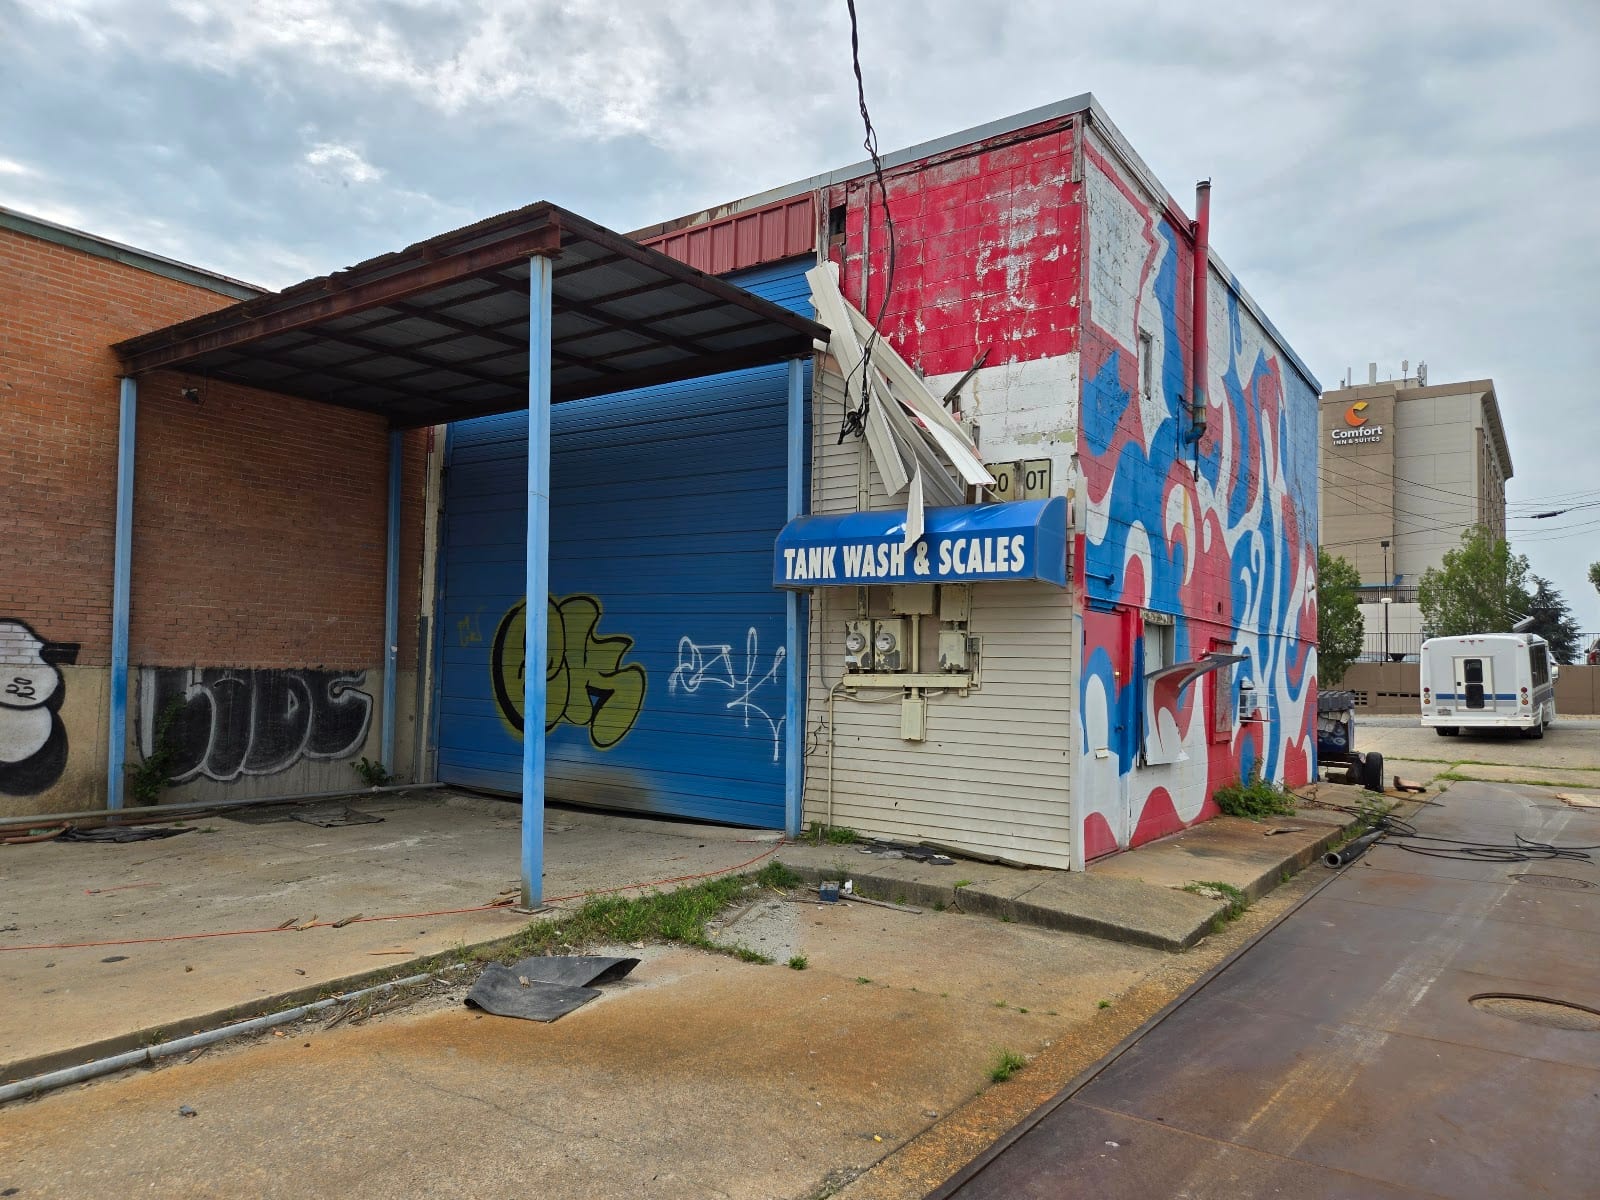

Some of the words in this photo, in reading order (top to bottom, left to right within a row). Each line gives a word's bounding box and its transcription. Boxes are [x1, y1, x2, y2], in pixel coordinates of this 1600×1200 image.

[1332, 426, 1383, 439] Comfort
[1354, 436, 1380, 444] SUITES
[1025, 470, 1047, 491] OT
[784, 545, 837, 580] TANK
[843, 542, 906, 578] WASH
[913, 541, 931, 576] &
[938, 534, 1025, 576] SCALES
